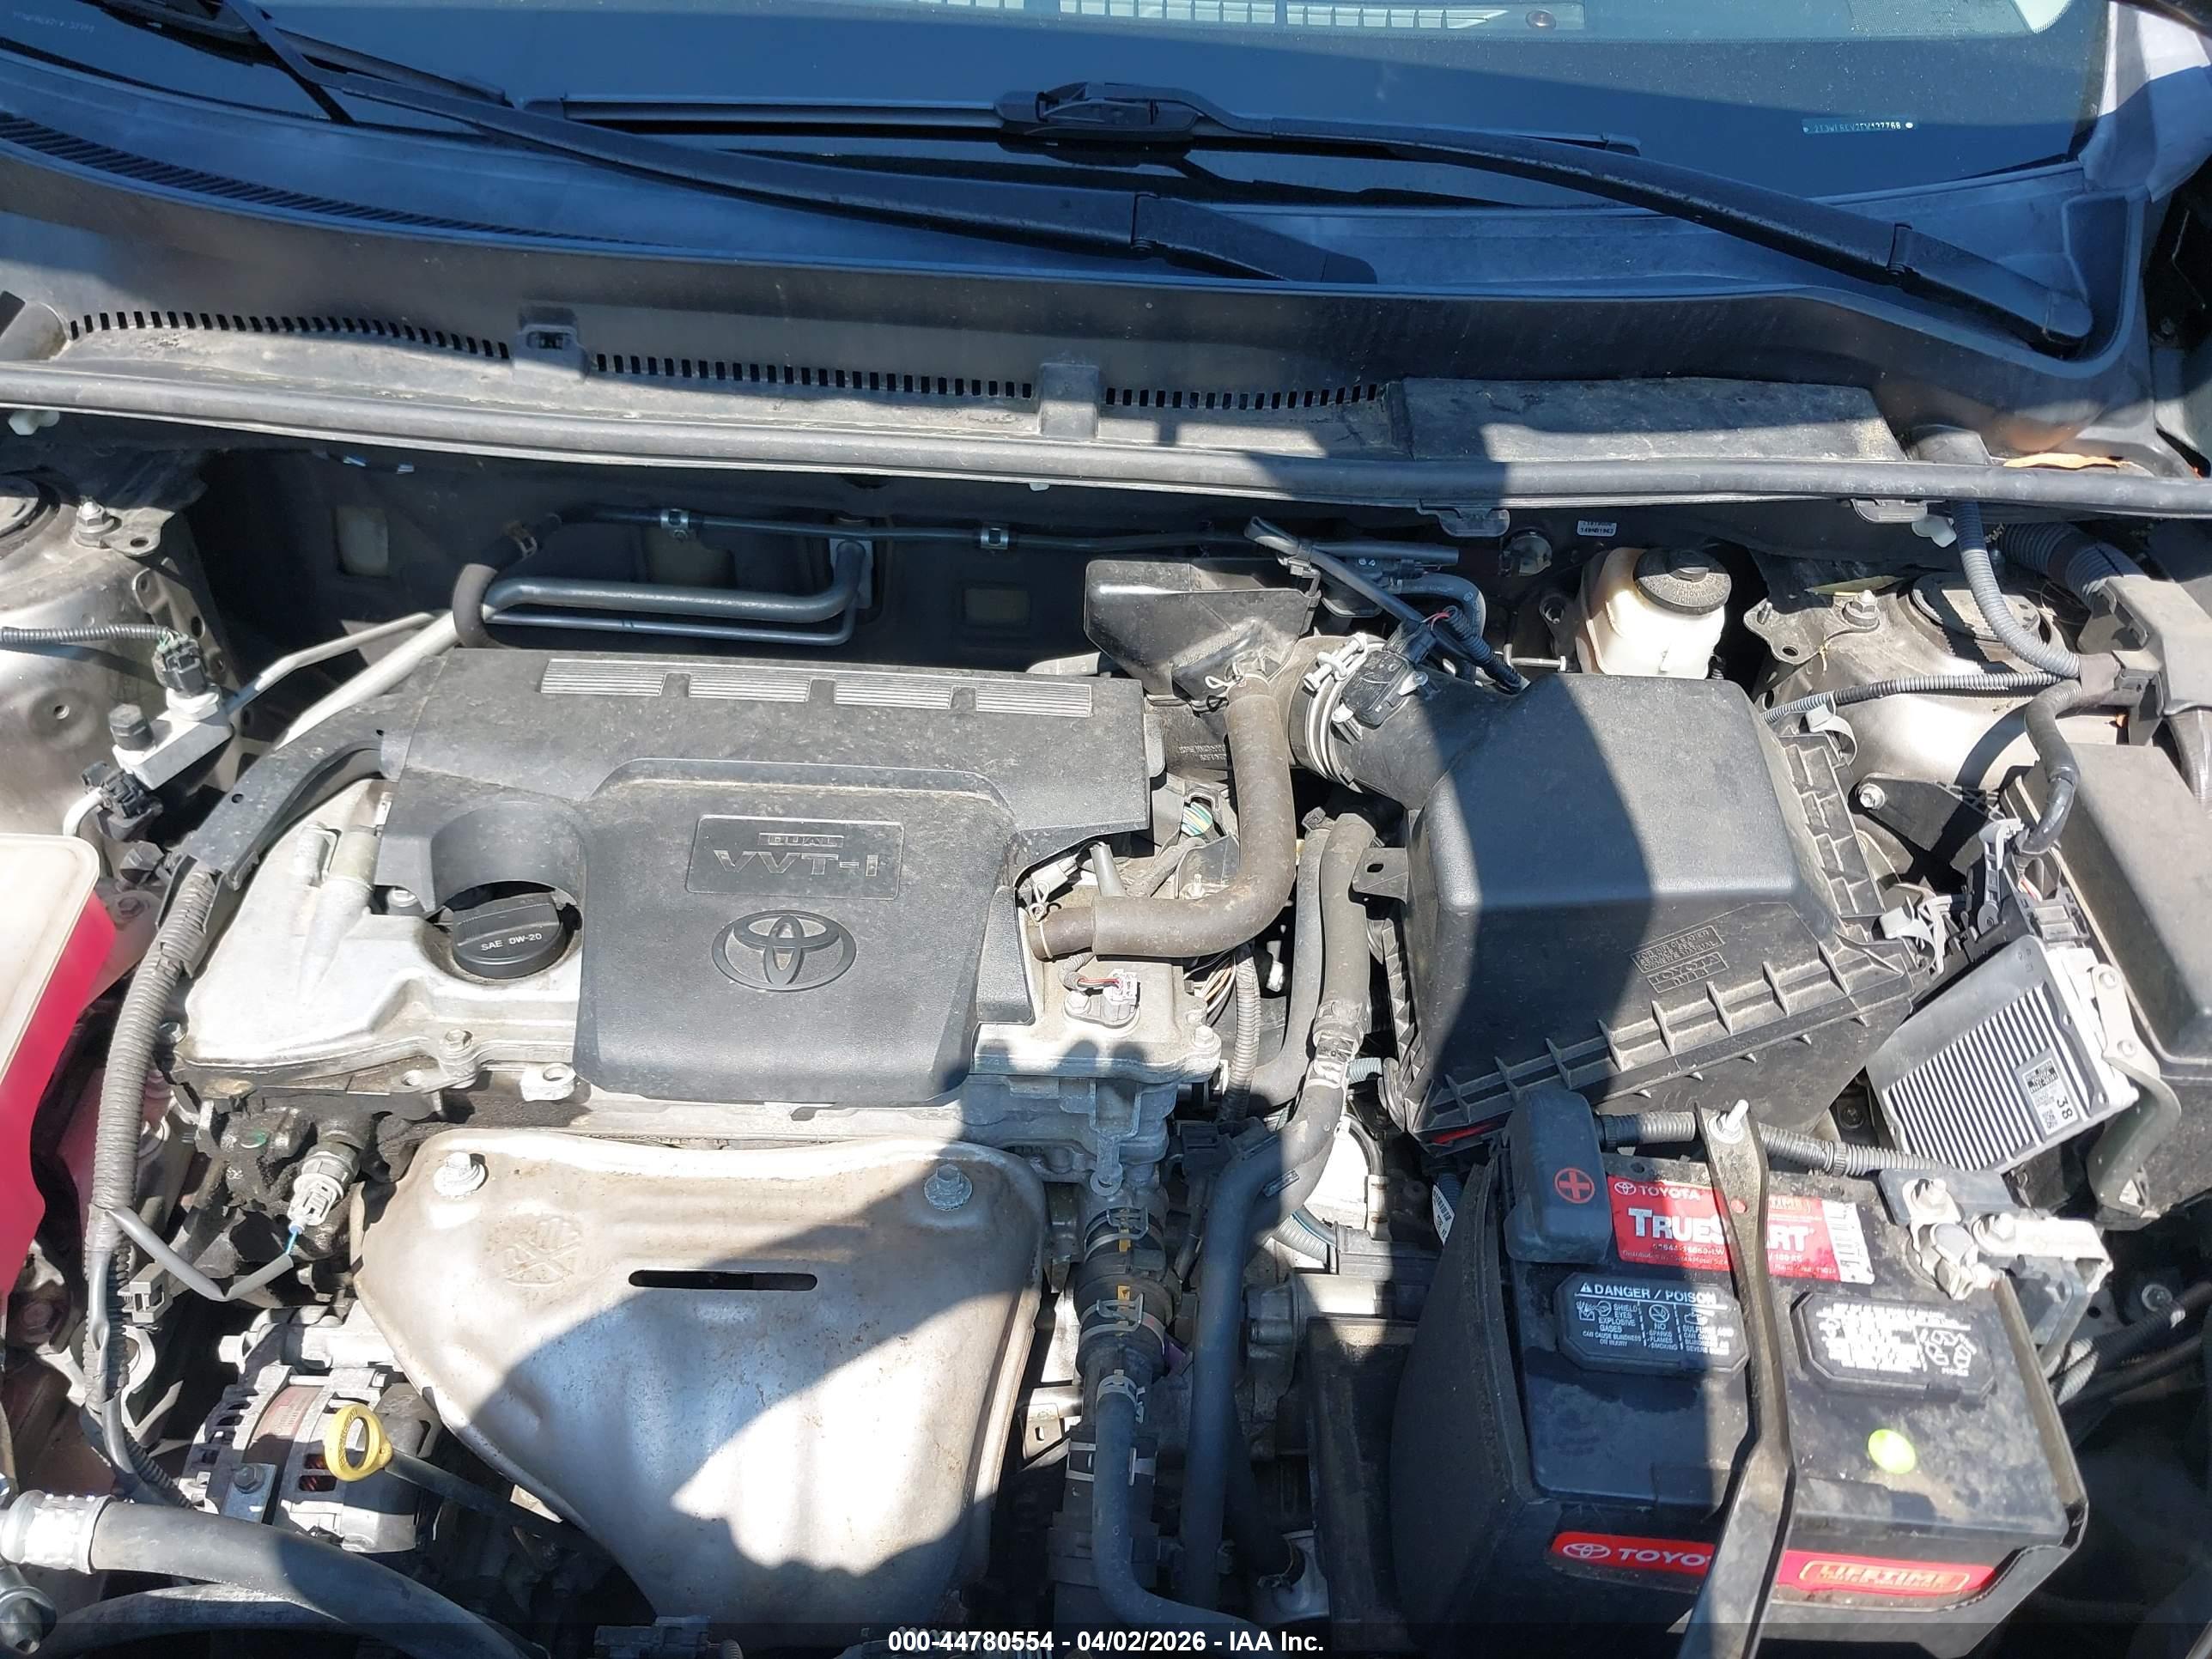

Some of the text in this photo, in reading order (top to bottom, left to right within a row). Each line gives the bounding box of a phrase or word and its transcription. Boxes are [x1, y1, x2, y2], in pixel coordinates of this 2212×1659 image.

[480, 933, 543, 951] SAE 0W-20
[2057, 1096, 2073, 1120] 38
[1639, 1185, 1701, 1201] TOYOTA
[1594, 1284, 1717, 1305] DANGER / POISON
[1613, 1303, 1638, 1313] SHIELD
[1598, 1317, 1636, 1328] EXPLOSIVE
[1618, 1548, 1711, 1567] TOYO
